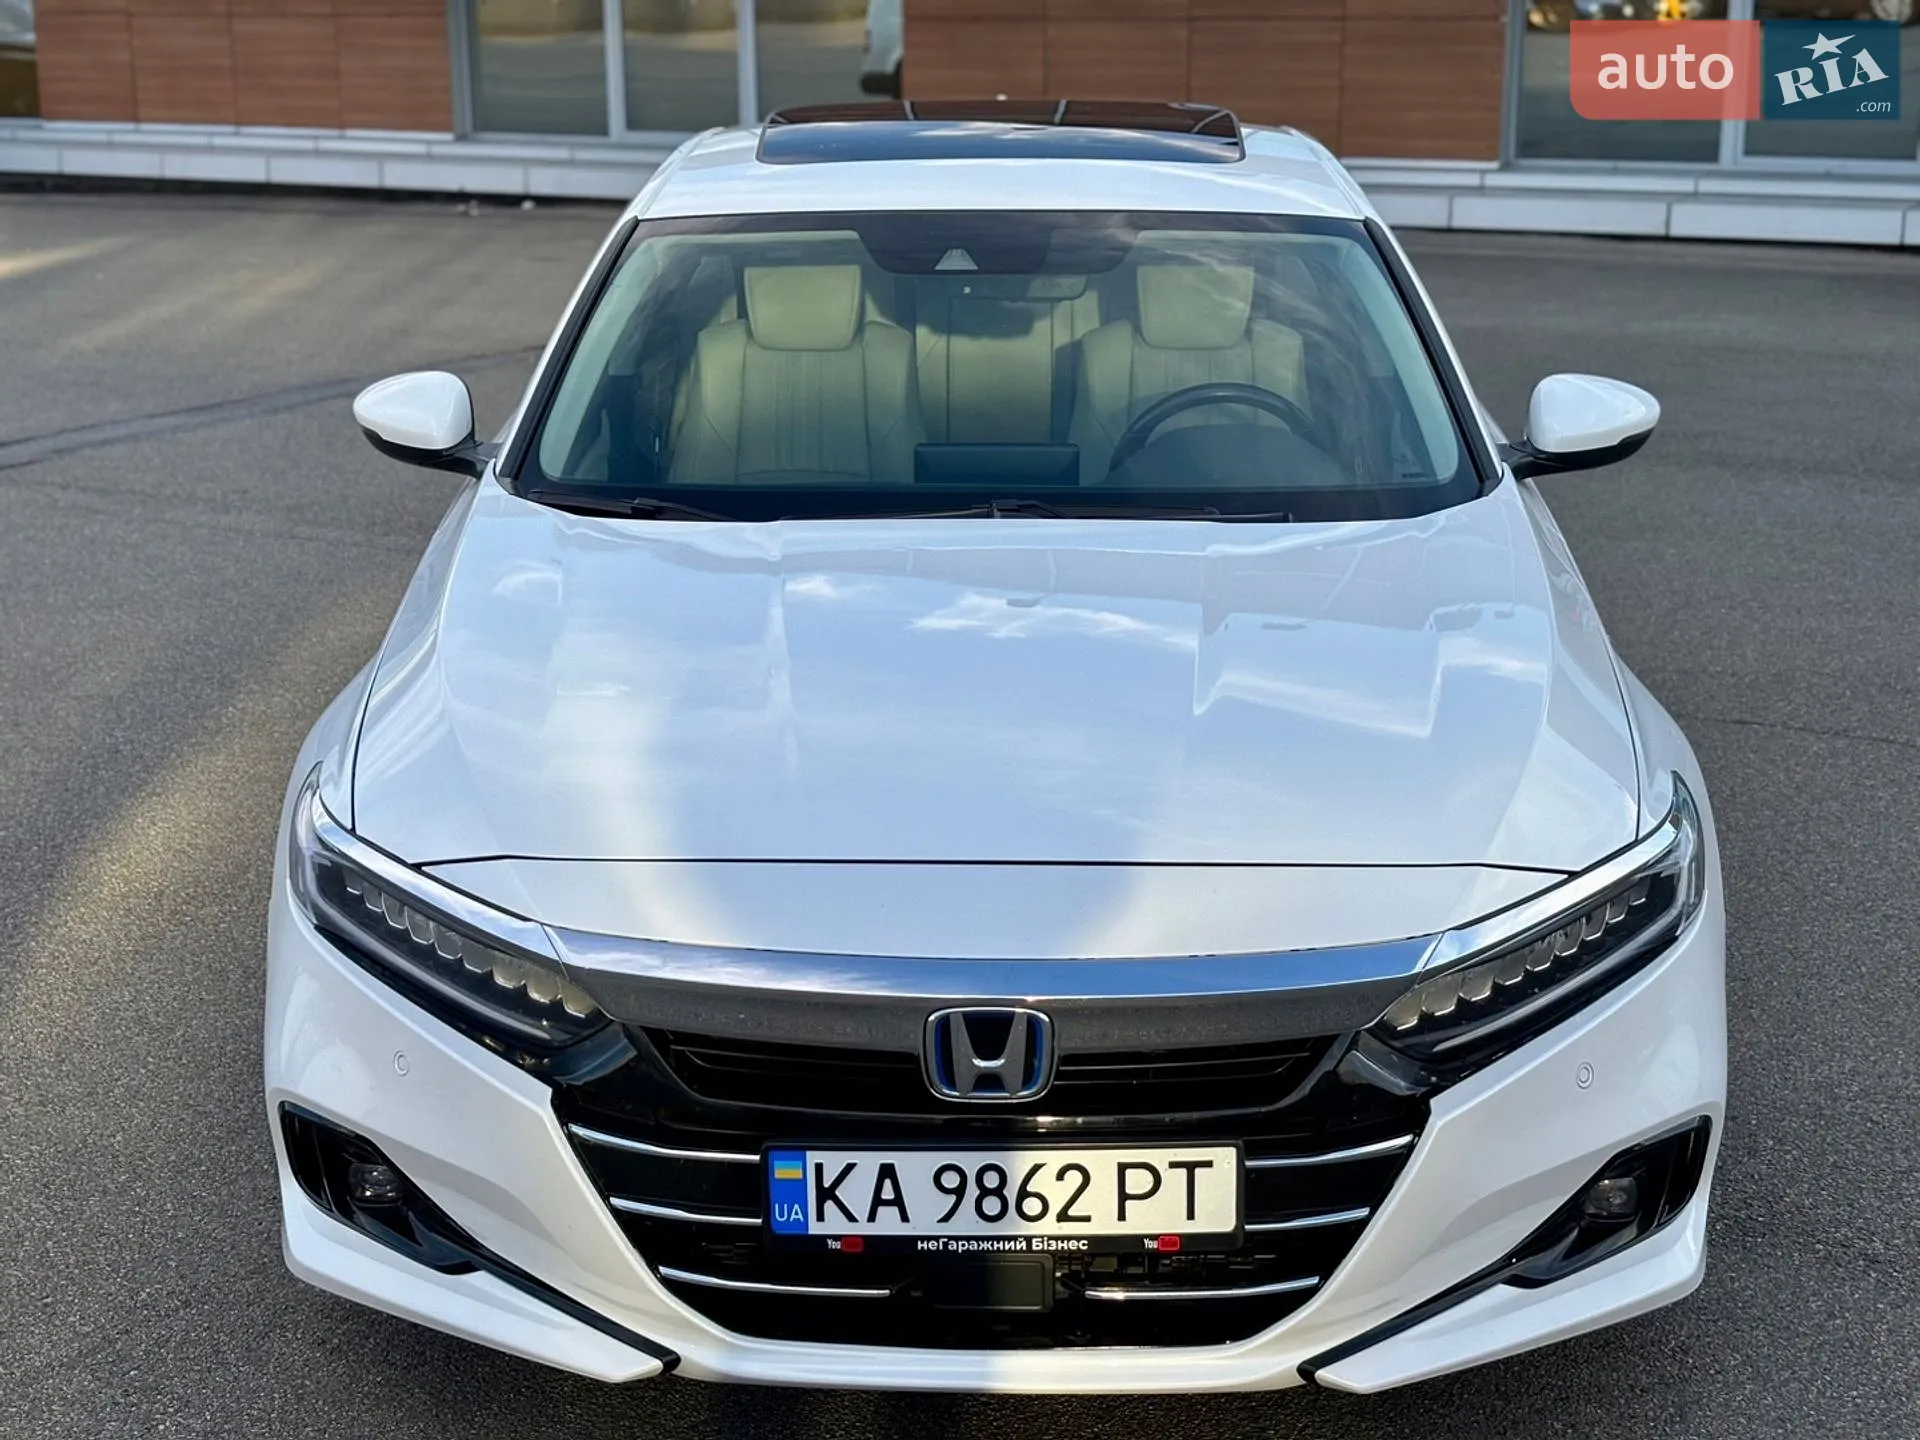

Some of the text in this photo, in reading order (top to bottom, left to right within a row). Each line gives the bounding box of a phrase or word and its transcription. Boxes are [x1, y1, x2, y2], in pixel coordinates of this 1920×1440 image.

[814, 1159, 1213, 1224] KA 9862 PT
[774, 1203, 804, 1223] UA
[917, 1236, 1089, 1253] неГаражний Бізнес
